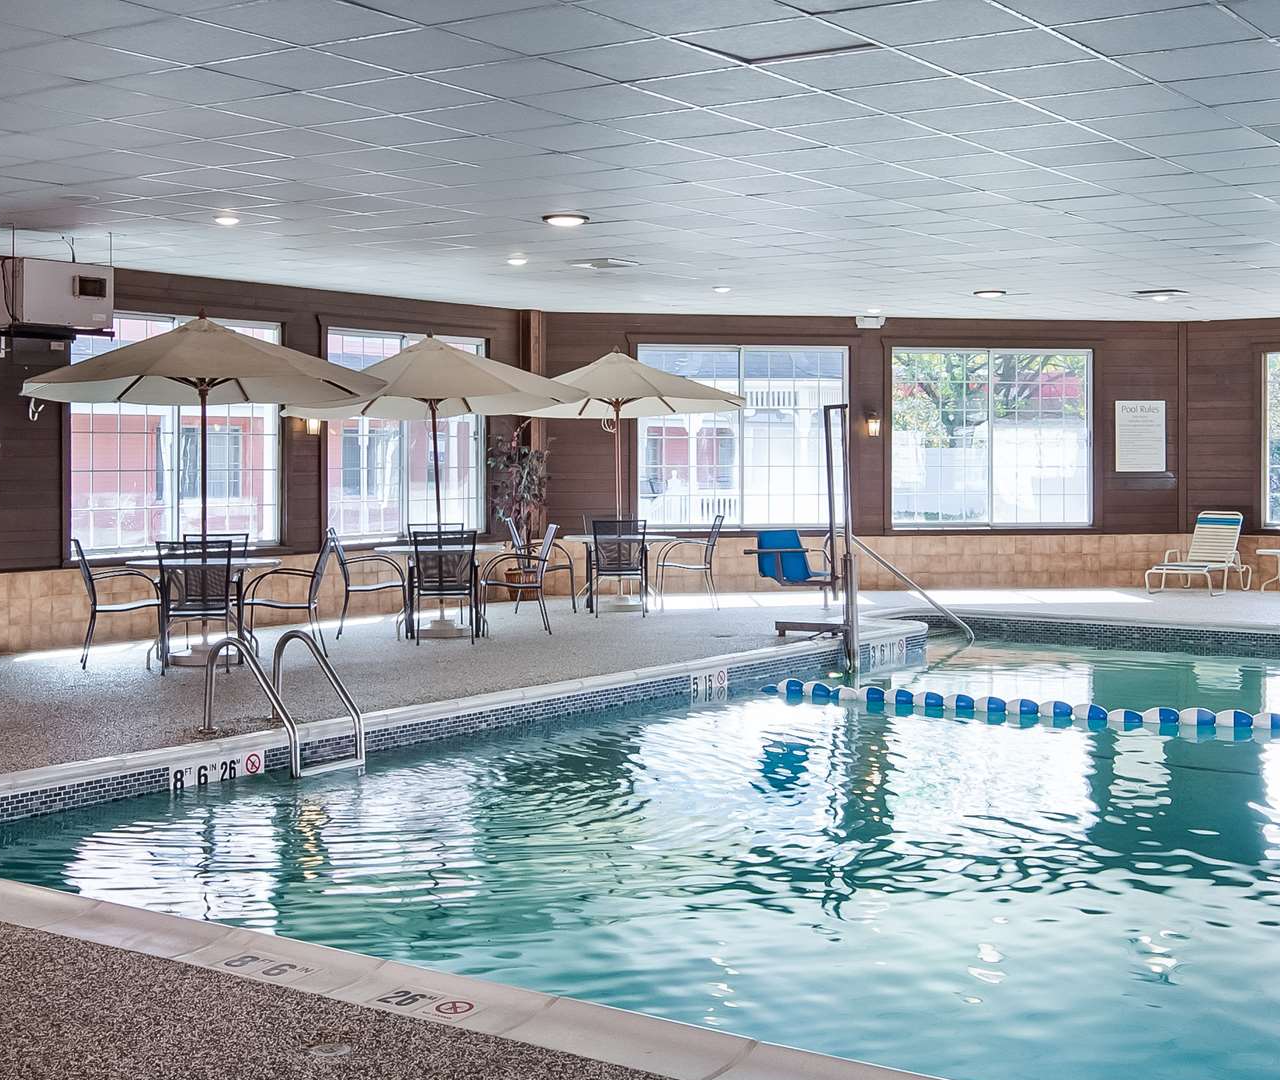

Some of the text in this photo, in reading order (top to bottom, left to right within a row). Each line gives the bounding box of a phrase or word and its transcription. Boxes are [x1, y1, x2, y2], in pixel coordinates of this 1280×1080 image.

[173, 770, 184, 790] 8
[197, 765, 208, 785] 6
[220, 760, 236, 781] 26
[224, 955, 260, 967] 8
[262, 963, 297, 976] 6
[376, 990, 427, 1006] 26
